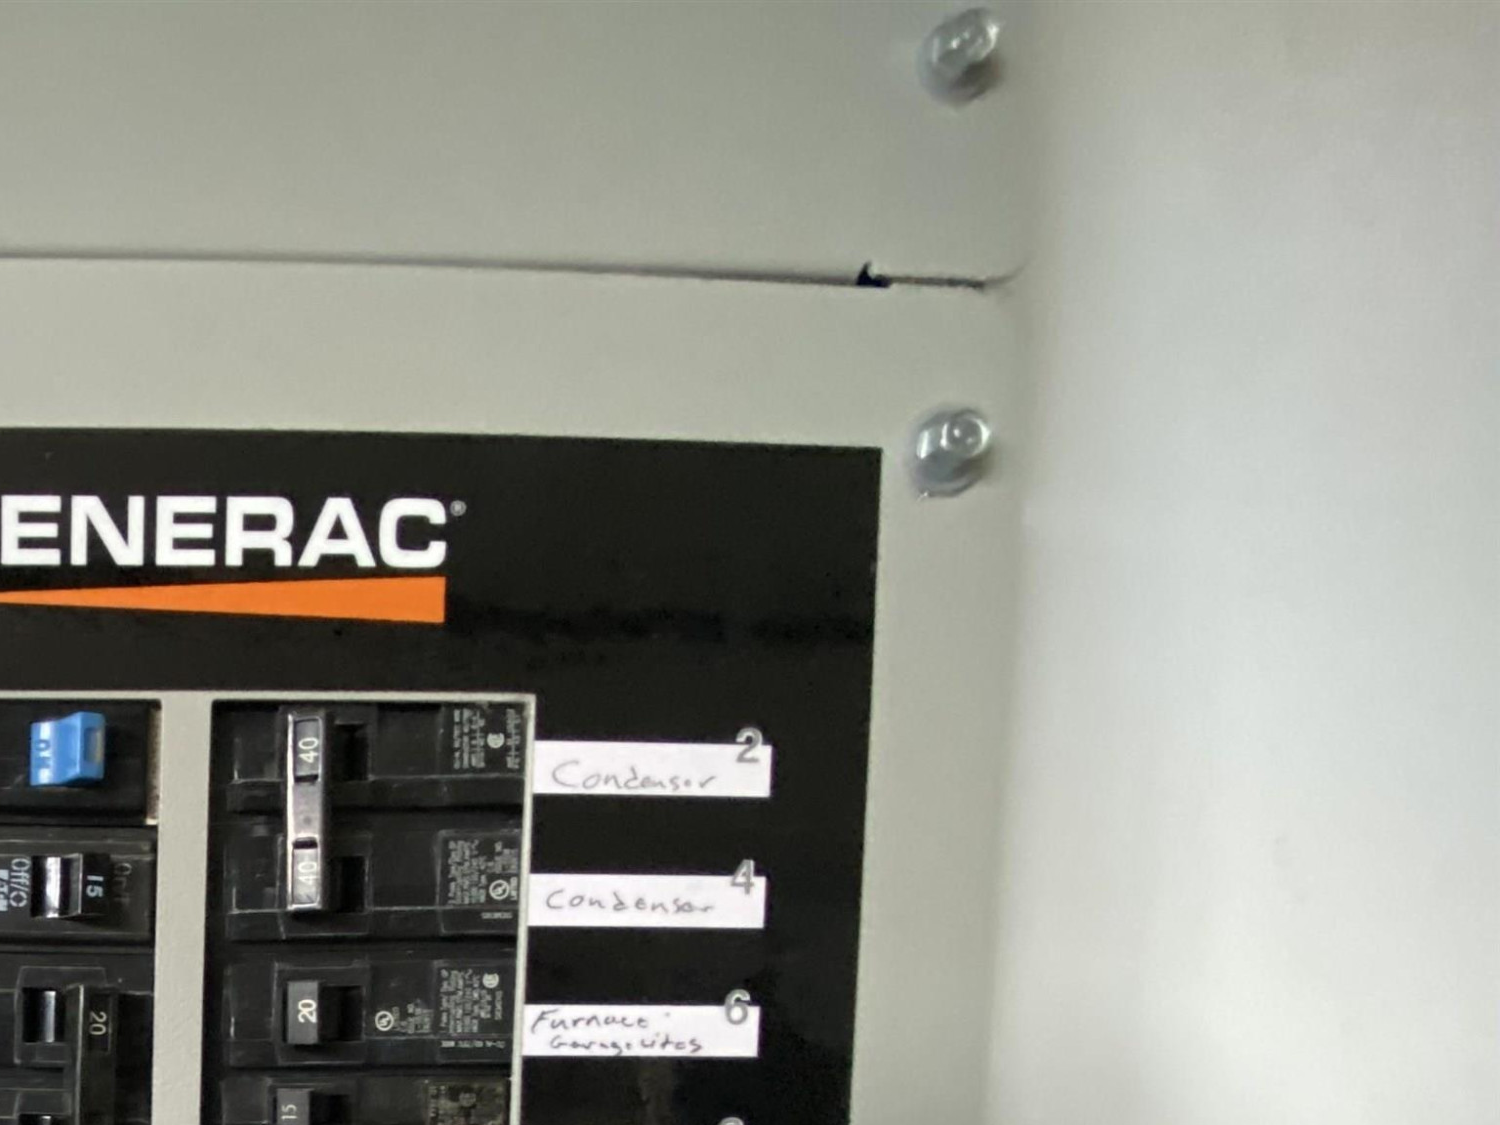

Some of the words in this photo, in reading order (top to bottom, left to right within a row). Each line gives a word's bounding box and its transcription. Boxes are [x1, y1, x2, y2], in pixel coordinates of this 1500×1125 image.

[299, 737, 319, 763] 40
[735, 727, 763, 764] 2
[86, 874, 104, 898] 15
[298, 860, 318, 886] 40
[731, 859, 755, 895] 4
[298, 999, 318, 1024] 20
[724, 988, 750, 1025] 6
[89, 1011, 107, 1036] 20
[281, 1103, 297, 1121] 15
